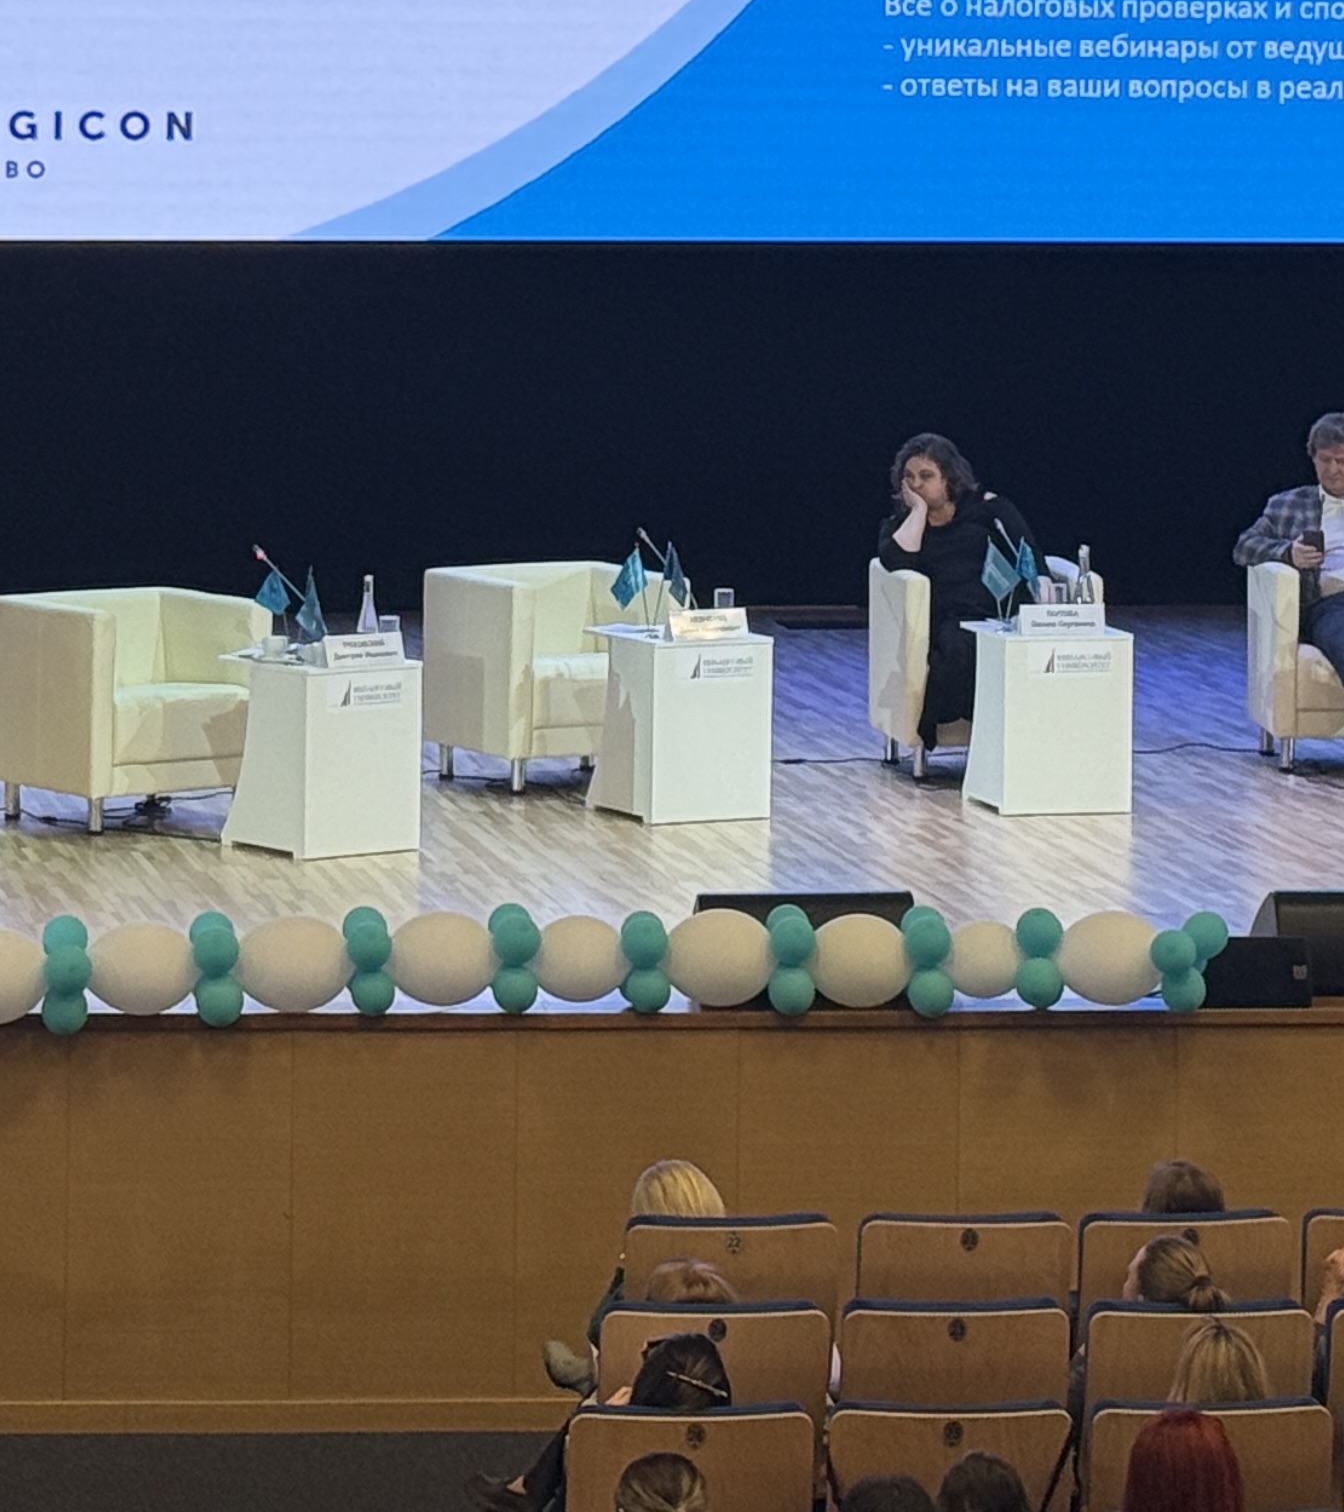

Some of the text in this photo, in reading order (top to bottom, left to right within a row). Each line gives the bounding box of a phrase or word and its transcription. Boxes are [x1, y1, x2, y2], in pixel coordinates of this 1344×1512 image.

[1122, 0, 1268, 25] проверках
[1275, 1, 1292, 20] и
[900, 38, 1072, 62] уникальные
[1079, 33, 1219, 64] вебинары
[1225, 39, 1259, 60] от
[900, 78, 998, 97] ответы
[1006, 78, 1038, 97] на
[1047, 79, 1120, 98] ваши
[1128, 79, 1248, 104] вопросы
[1256, 80, 1272, 99] в
